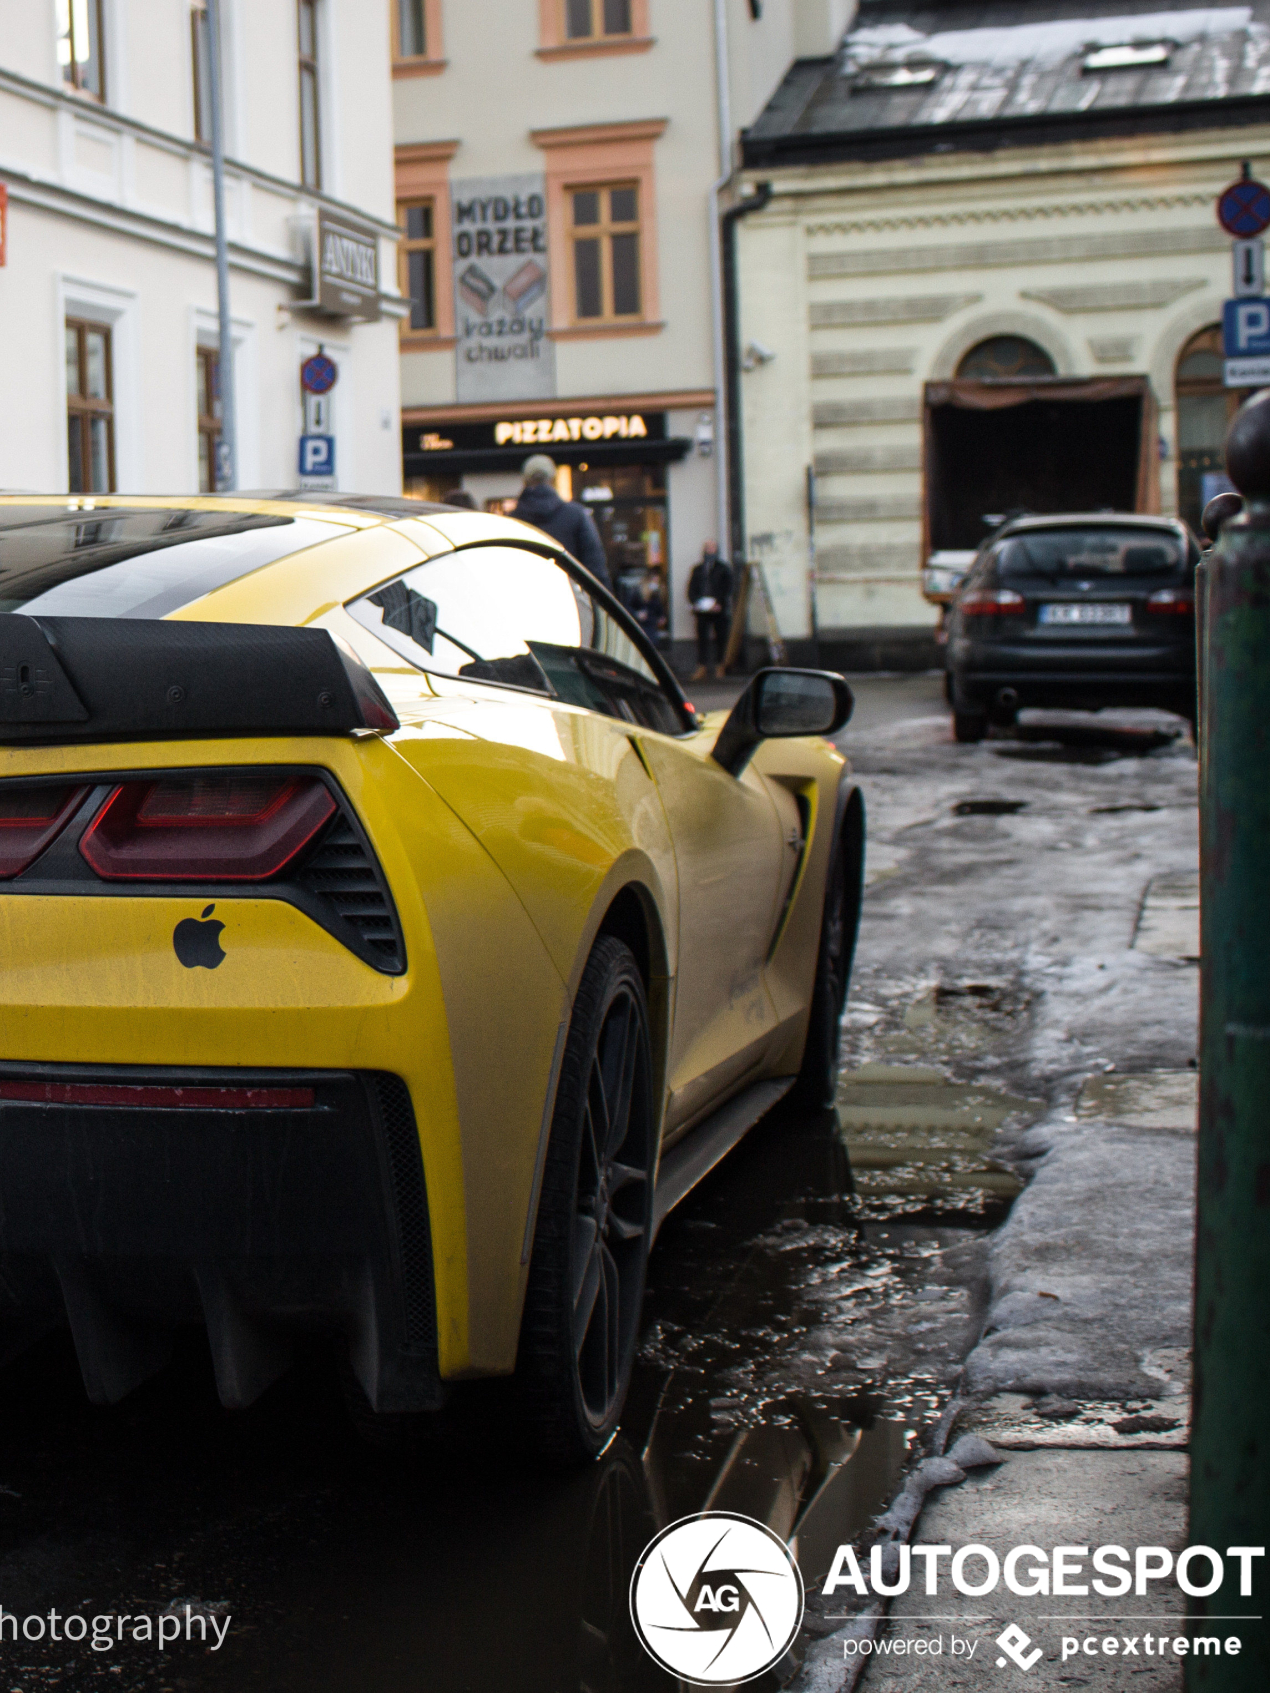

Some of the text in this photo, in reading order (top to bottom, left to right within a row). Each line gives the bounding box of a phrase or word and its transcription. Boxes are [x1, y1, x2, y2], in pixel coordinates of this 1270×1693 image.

[456, 193, 544, 224] MYDŁO
[457, 225, 546, 258] ORZEŁ
[322, 231, 375, 286] ANTYKI
[1237, 303, 1270, 350] P
[465, 341, 540, 363] chwali
[495, 414, 647, 445] PIZZATOPIA
[304, 439, 329, 472] P
